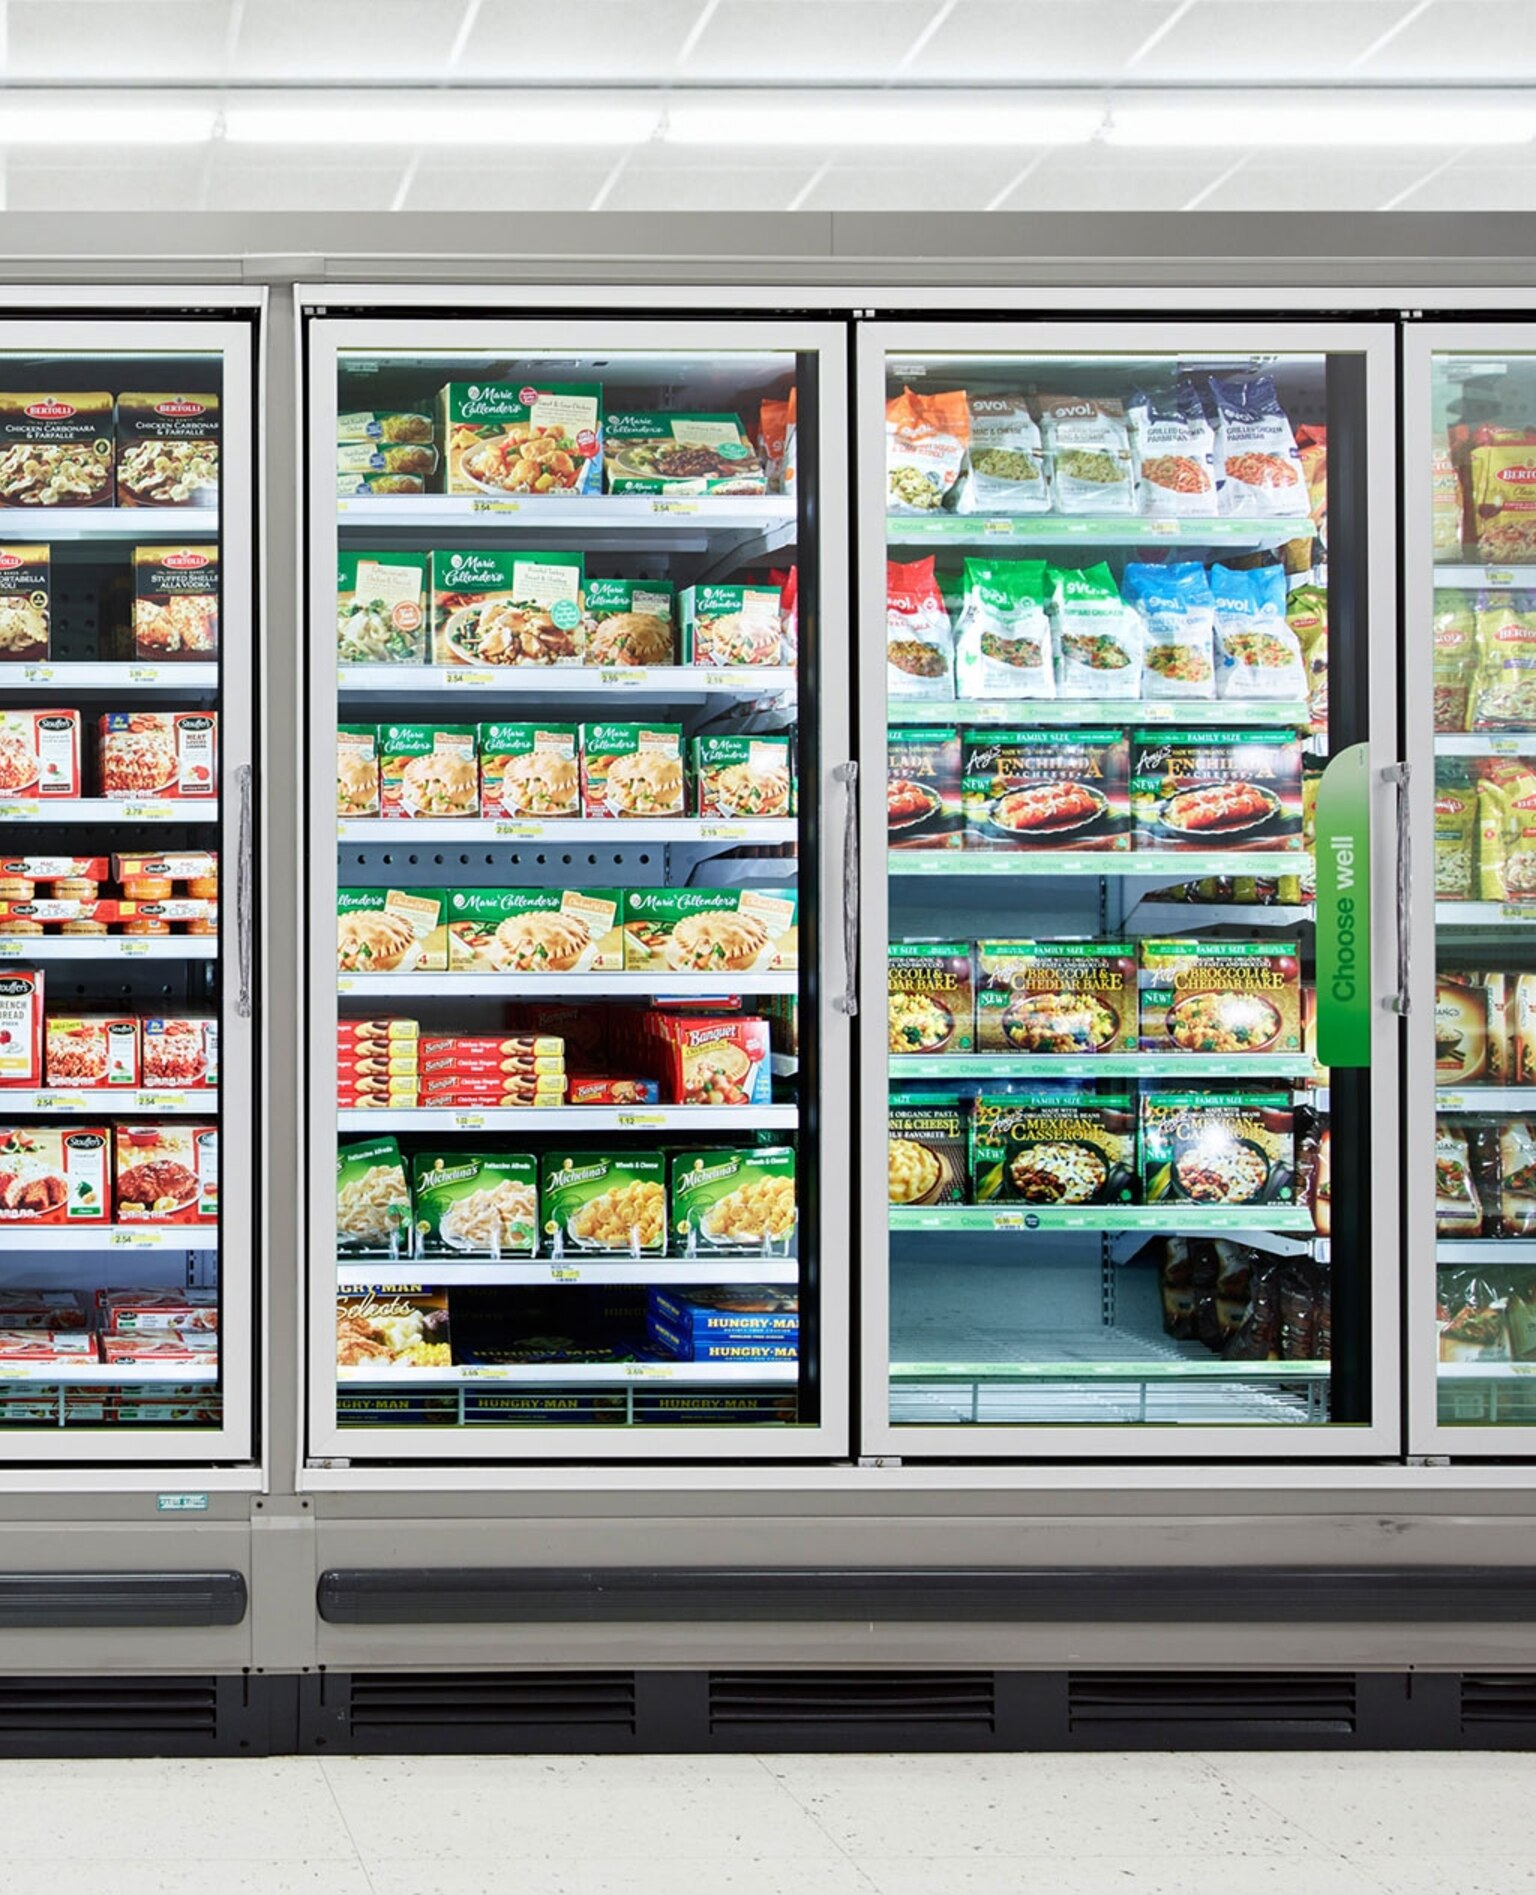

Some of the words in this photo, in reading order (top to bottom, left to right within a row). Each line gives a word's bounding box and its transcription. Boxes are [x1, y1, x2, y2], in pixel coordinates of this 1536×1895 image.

[481, 387, 513, 403] Marie
[30, 407, 71, 415] BERTOLLI
[160, 405, 201, 413] BERTOLLI
[459, 402, 521, 417] Callender's
[973, 401, 1012, 411] evol.
[1056, 404, 1095, 417] evol.
[620, 416, 652, 425] Marie
[606, 425, 664, 434] Callender's
[463, 556, 496, 572] Marie
[442, 570, 504, 586] Callender's
[183, 581, 211, 589] VODKA
[598, 584, 624, 594] Marie
[712, 589, 736, 599] Marie
[586, 596, 630, 607] Callender's
[1215, 598, 1251, 612] evol.
[41, 718, 73, 729] Stouffer's
[398, 729, 425, 741] Marie
[498, 728, 525, 740] Marie
[602, 728, 629, 740] Marie
[1017, 733, 1047, 742] FAMILY
[1050, 733, 1070, 741] SIZE
[1187, 734, 1220, 742] FAMILY
[1222, 734, 1241, 742] SIZE
[382, 740, 432, 752] Callender's
[586, 739, 636, 752] Callender's
[716, 741, 742, 752] Marie
[963, 780, 990, 791] NEW!
[1133, 780, 1161, 790] NEW!
[1331, 836, 1354, 890] well
[464, 896, 497, 912] Marie
[497, 894, 560, 909] Callender's
[641, 895, 673, 912] Marie
[673, 894, 737, 909] Callender's
[1196, 946, 1226, 954] FAMILY
[1332, 897, 1355, 1002] Choose
[1011, 973, 1077, 991] CHEDDAR
[1081, 974, 1123, 990] BAKE
[1174, 973, 1243, 990] CHEDDAR
[1245, 973, 1284, 990] BAKE
[1145, 992, 1171, 1002] NEW!
[690, 1025, 742, 1045] Banquet
[36, 1098, 53, 1106] 2.54
[913, 1118, 960, 1137] CHEESE
[1026, 1118, 1092, 1129] MEXICAN
[70, 1137, 101, 1148] Stouffer's
[417, 1165, 478, 1192] Michelina's
[547, 1165, 607, 1192] Michelina's
[677, 1165, 738, 1192] Michelina's
